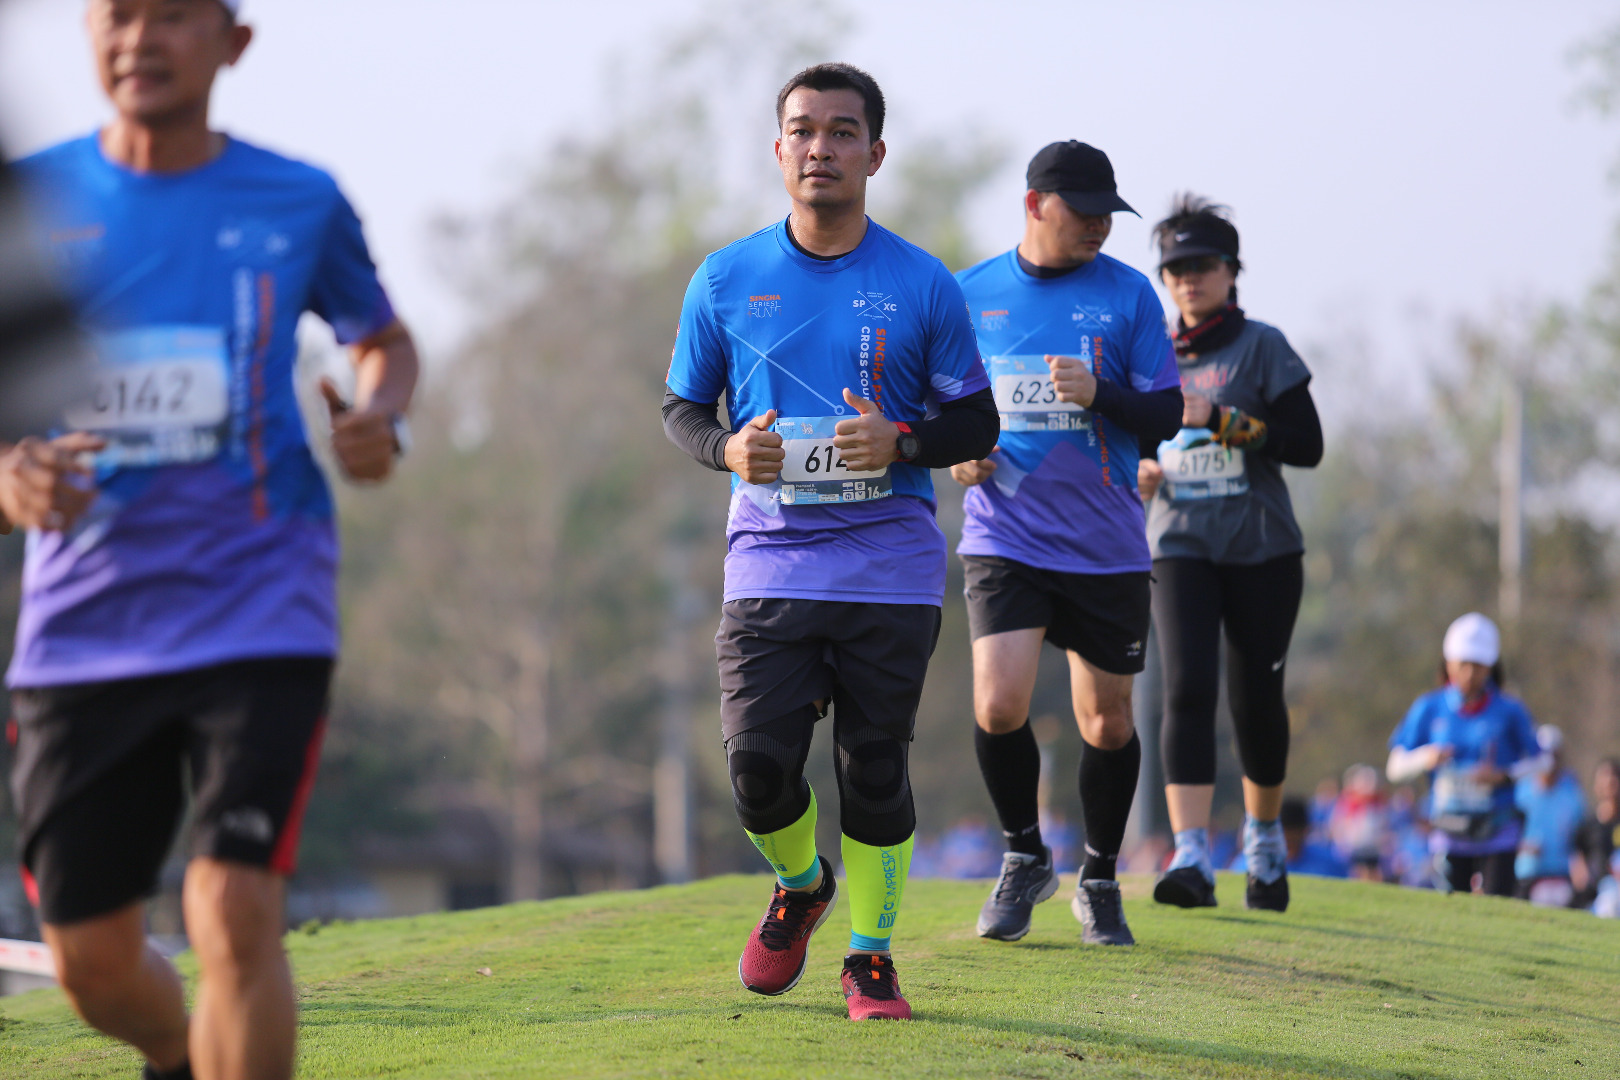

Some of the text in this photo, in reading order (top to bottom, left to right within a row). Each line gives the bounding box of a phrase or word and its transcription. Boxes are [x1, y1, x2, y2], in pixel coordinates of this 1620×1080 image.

[749, 294, 781, 302] SINGHA
[852, 299, 898, 312] SP XC
[859, 325, 871, 367] CROSS
[872, 327, 887, 381] SINGHA
[1093, 336, 1103, 376] SINGH
[1012, 380, 1056, 404] 623
[804, 445, 850, 473] 614
[1179, 450, 1226, 476] 6175
[880, 846, 897, 911] COMPRESSPO
